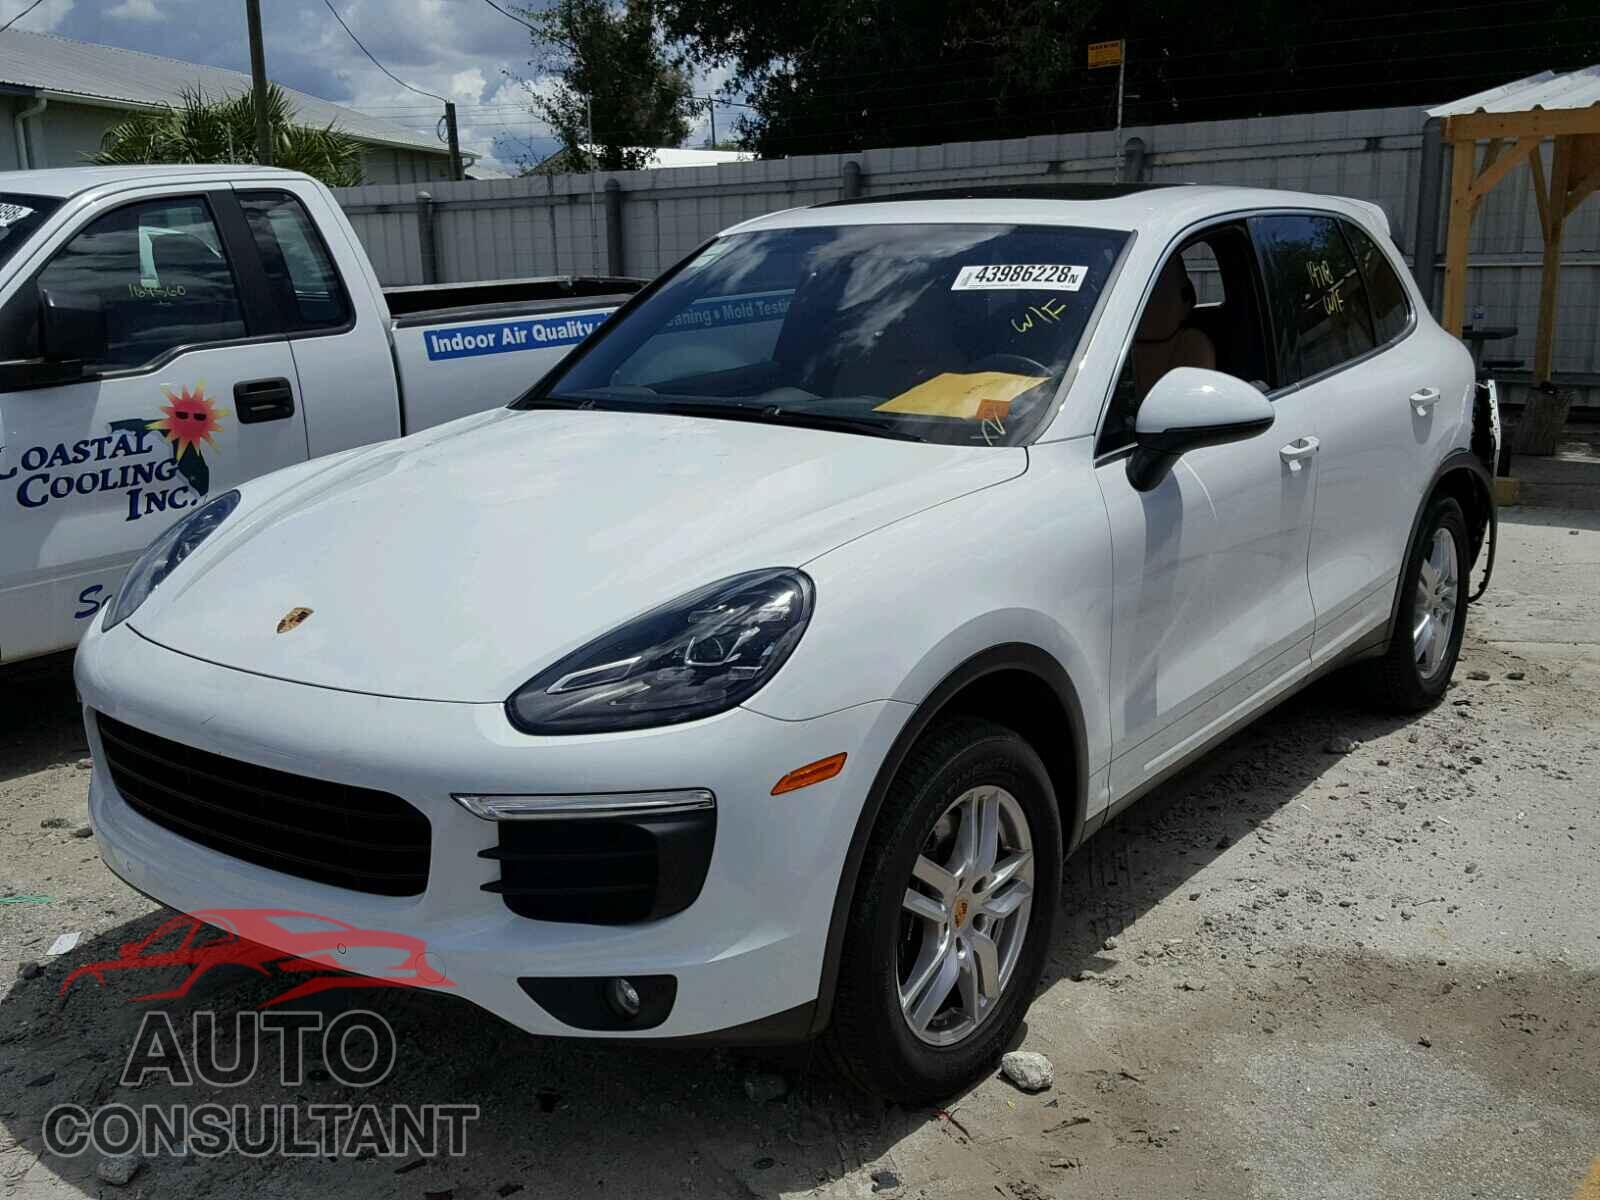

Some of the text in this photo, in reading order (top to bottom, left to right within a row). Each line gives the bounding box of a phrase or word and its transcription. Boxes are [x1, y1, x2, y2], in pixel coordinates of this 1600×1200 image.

[974, 265, 1071, 283] 43986228
[722, 303, 755, 320] Mold
[430, 320, 594, 354] Indoor Air Quality
[16, 459, 179, 509] COOLING
[125, 486, 198, 521] INC.
